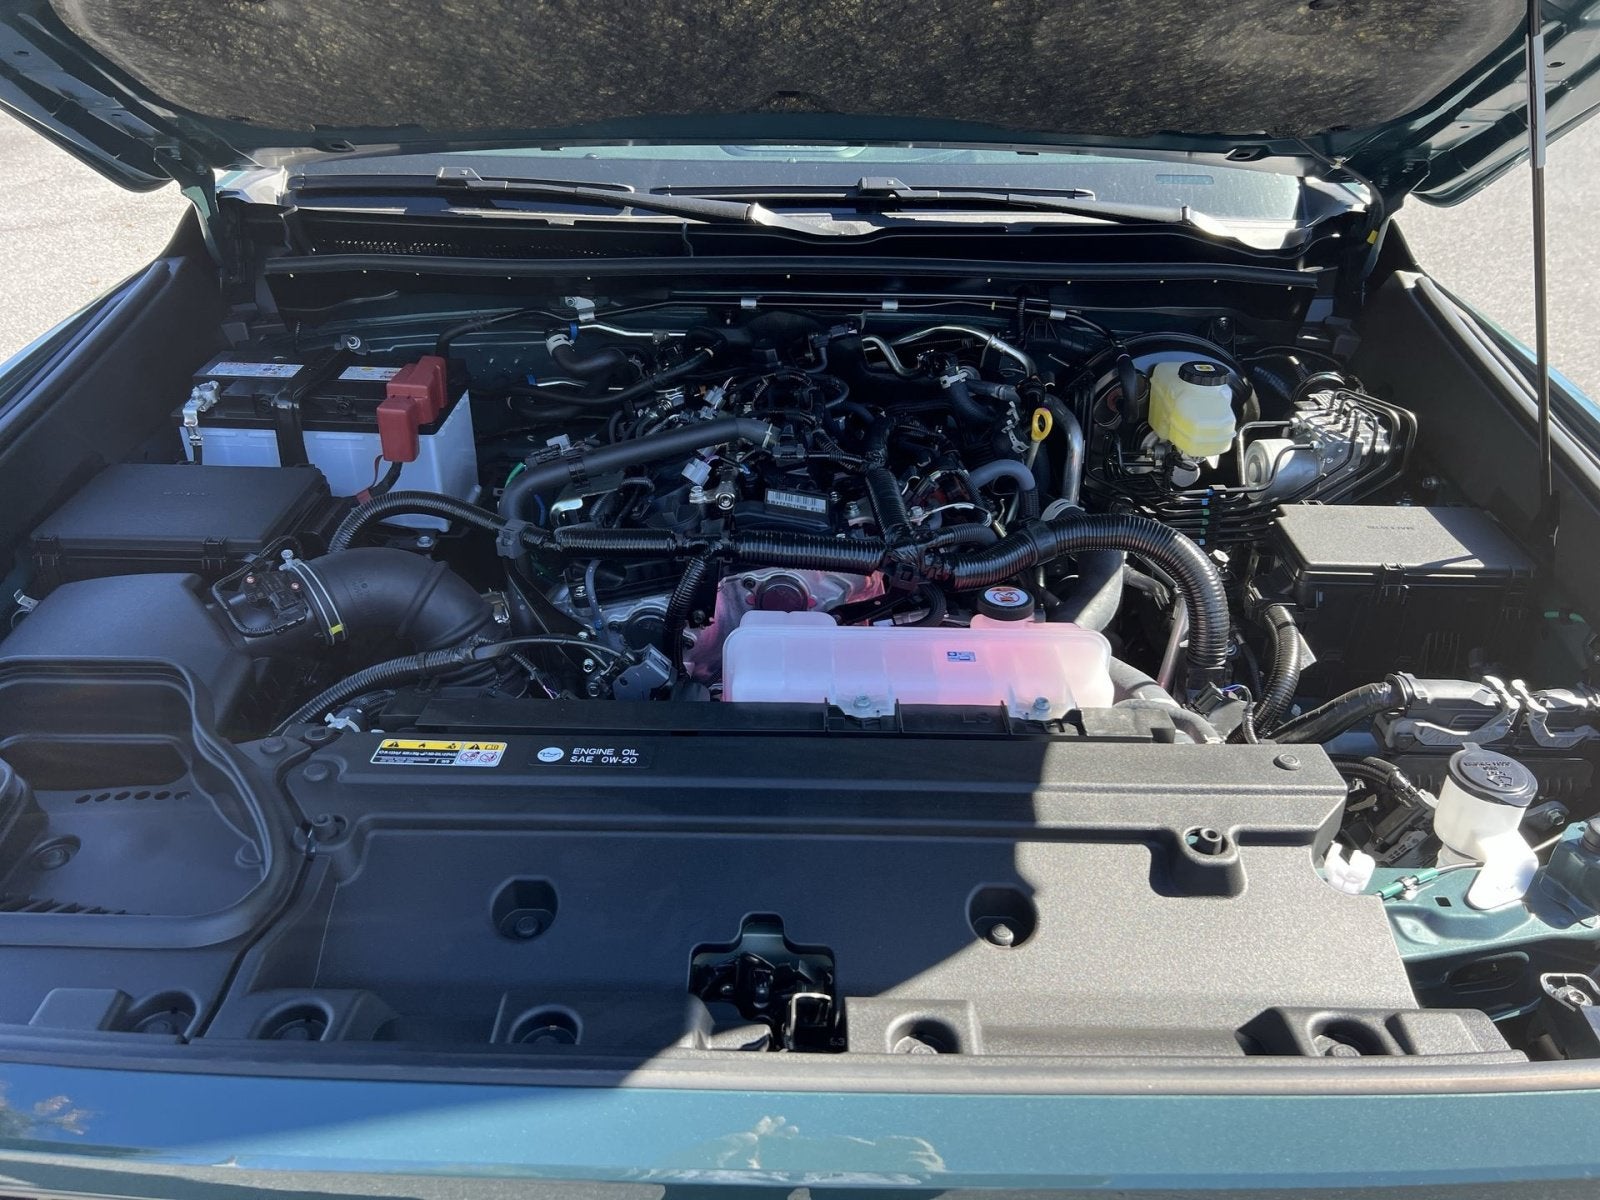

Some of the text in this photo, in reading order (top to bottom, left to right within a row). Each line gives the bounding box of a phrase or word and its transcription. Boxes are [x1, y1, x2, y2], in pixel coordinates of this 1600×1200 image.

[572, 747, 640, 756] ENGINE OIL
[569, 755, 638, 764] SAE 0W-20
